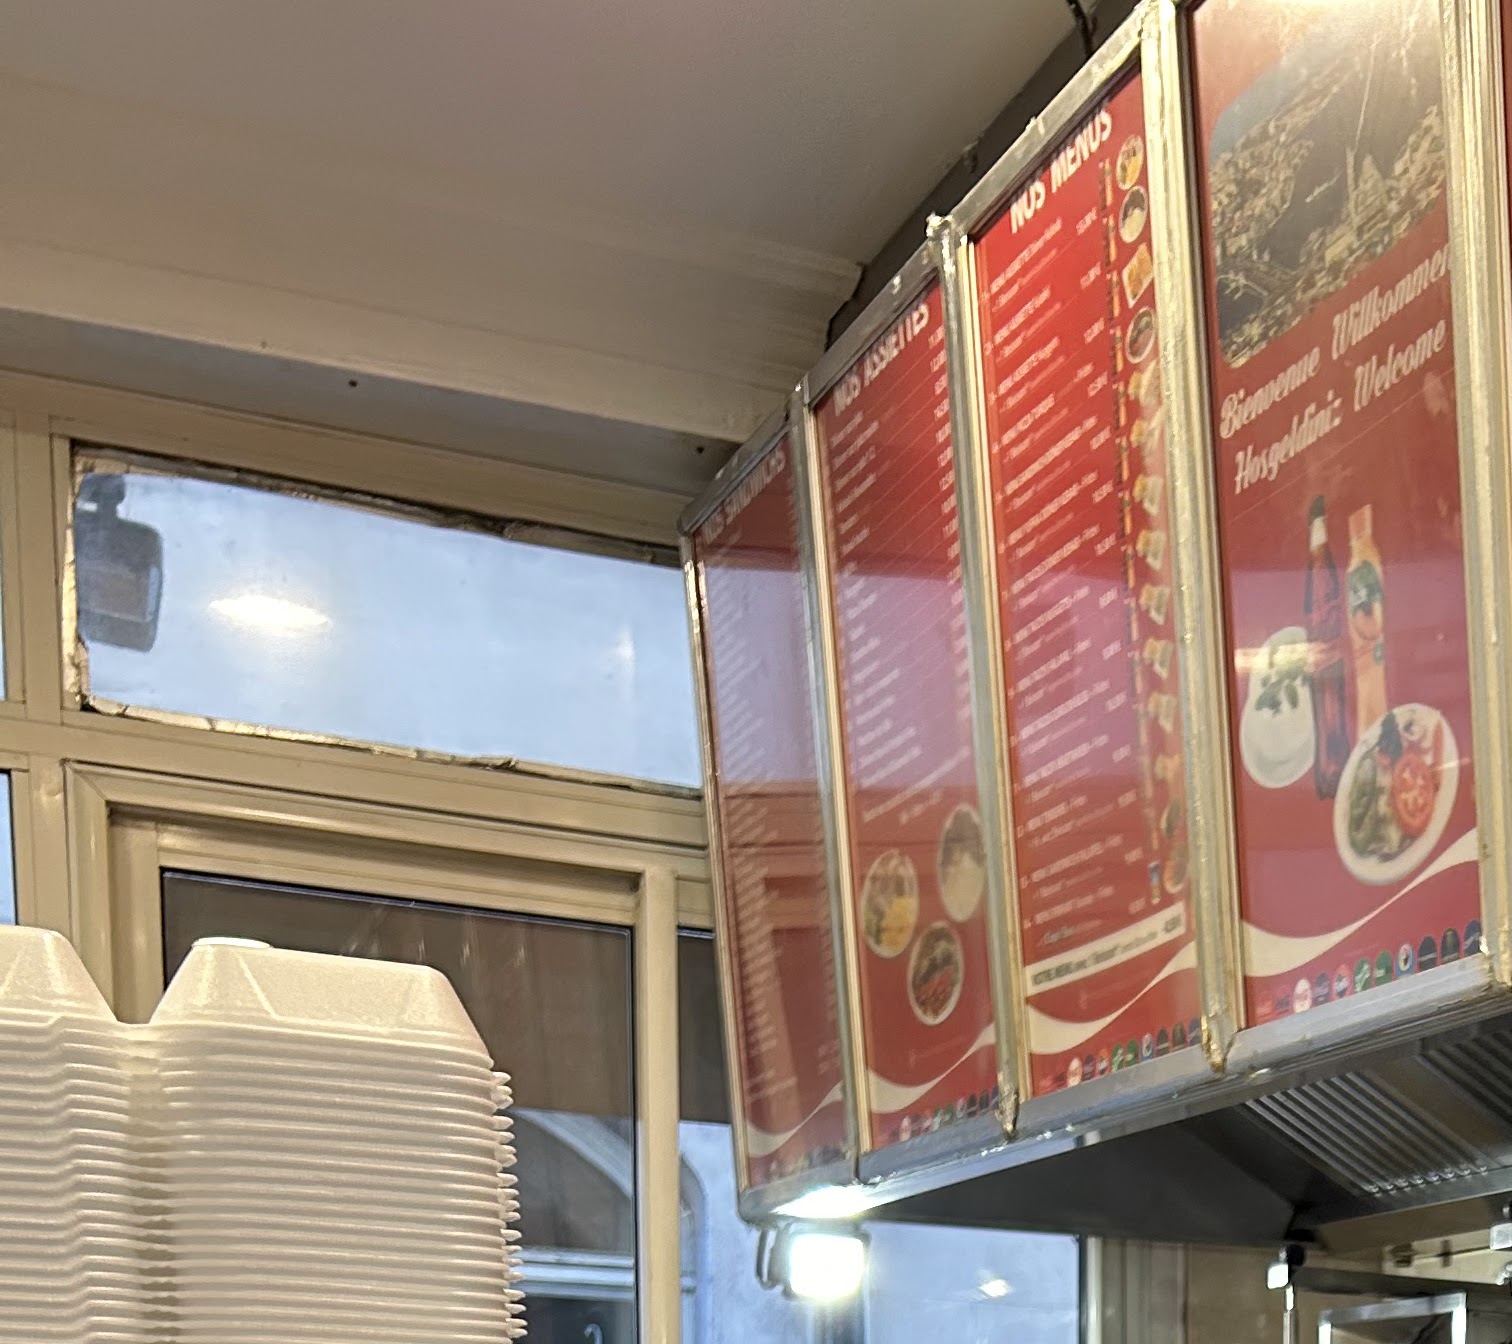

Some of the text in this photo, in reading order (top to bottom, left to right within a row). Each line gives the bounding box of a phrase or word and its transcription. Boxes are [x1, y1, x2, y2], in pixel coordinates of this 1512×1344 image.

[1050, 110, 1112, 194] MENUS
[1220, 346, 1320, 440] Bienvenue
[1353, 319, 1446, 413] Welcome
